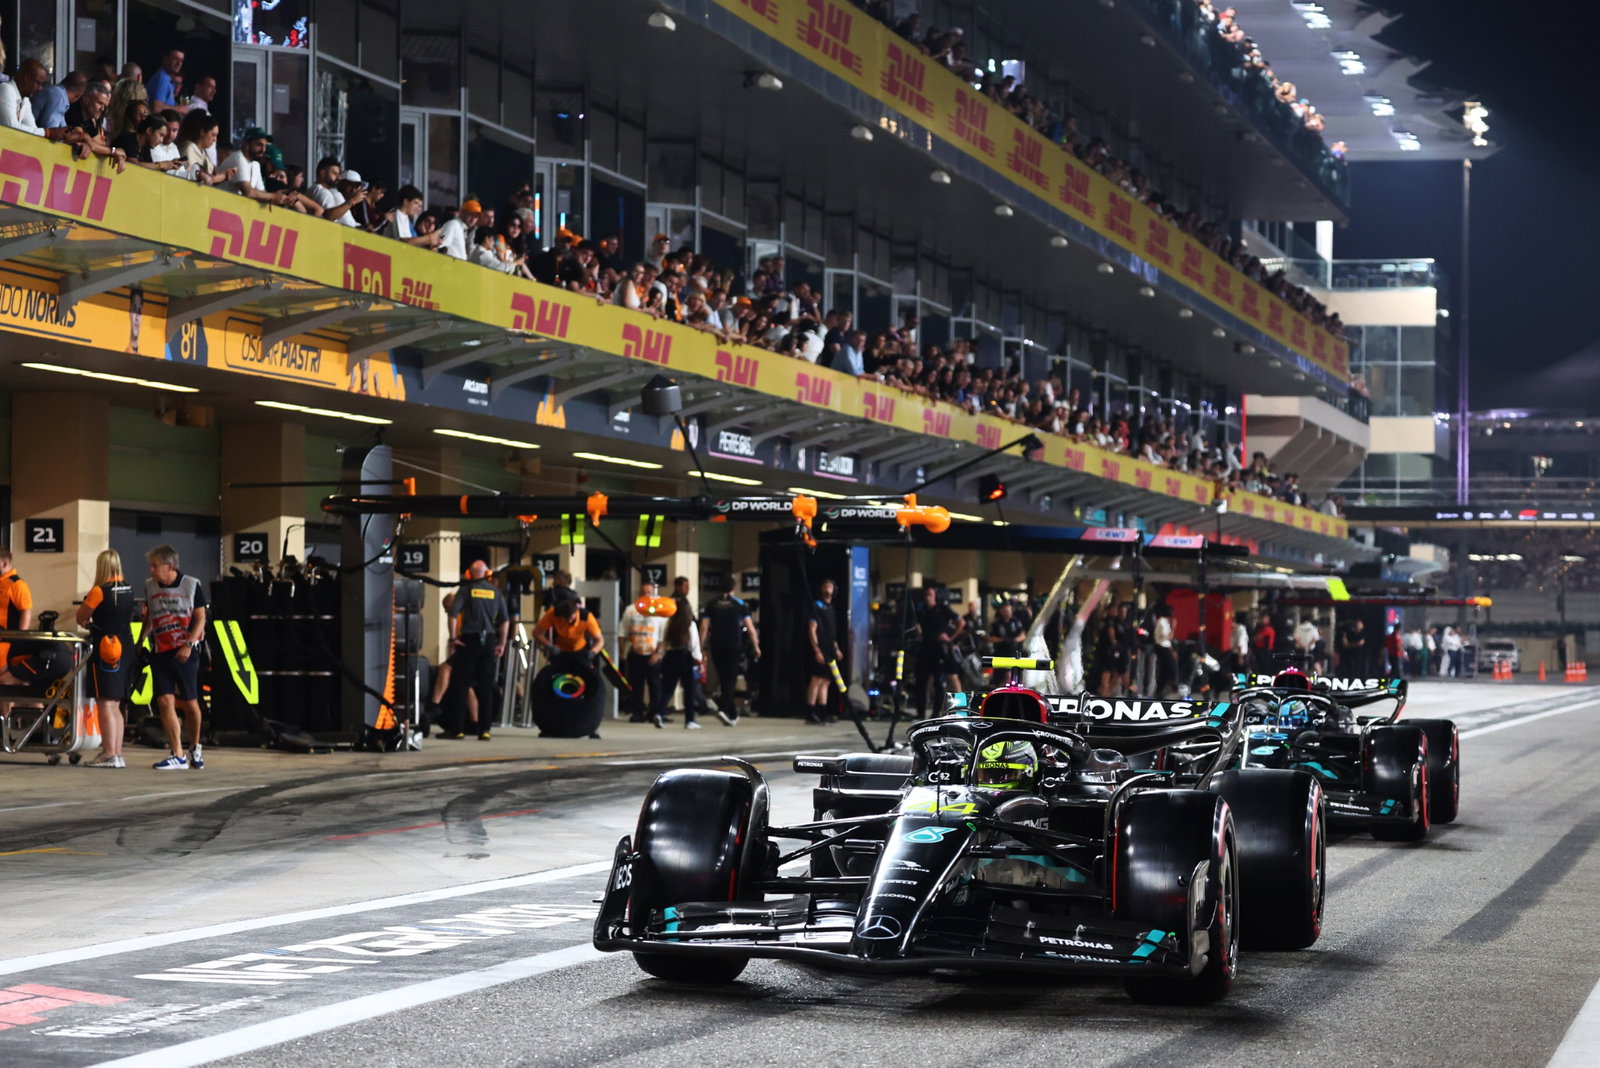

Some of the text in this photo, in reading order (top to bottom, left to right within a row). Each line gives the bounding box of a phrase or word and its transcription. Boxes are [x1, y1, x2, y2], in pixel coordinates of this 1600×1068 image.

[883, 42, 932, 117] DHL
[0, 283, 23, 318] DO
[181, 322, 198, 361] 81
[280, 340, 321, 373] PIASTRI
[732, 501, 793, 511] DP WORLD
[841, 509, 897, 519] DP WORLD
[33, 528, 57, 543] 21
[240, 540, 263, 555] 20
[404, 551, 424, 564] 19
[1039, 936, 1113, 950] PETRONAS
